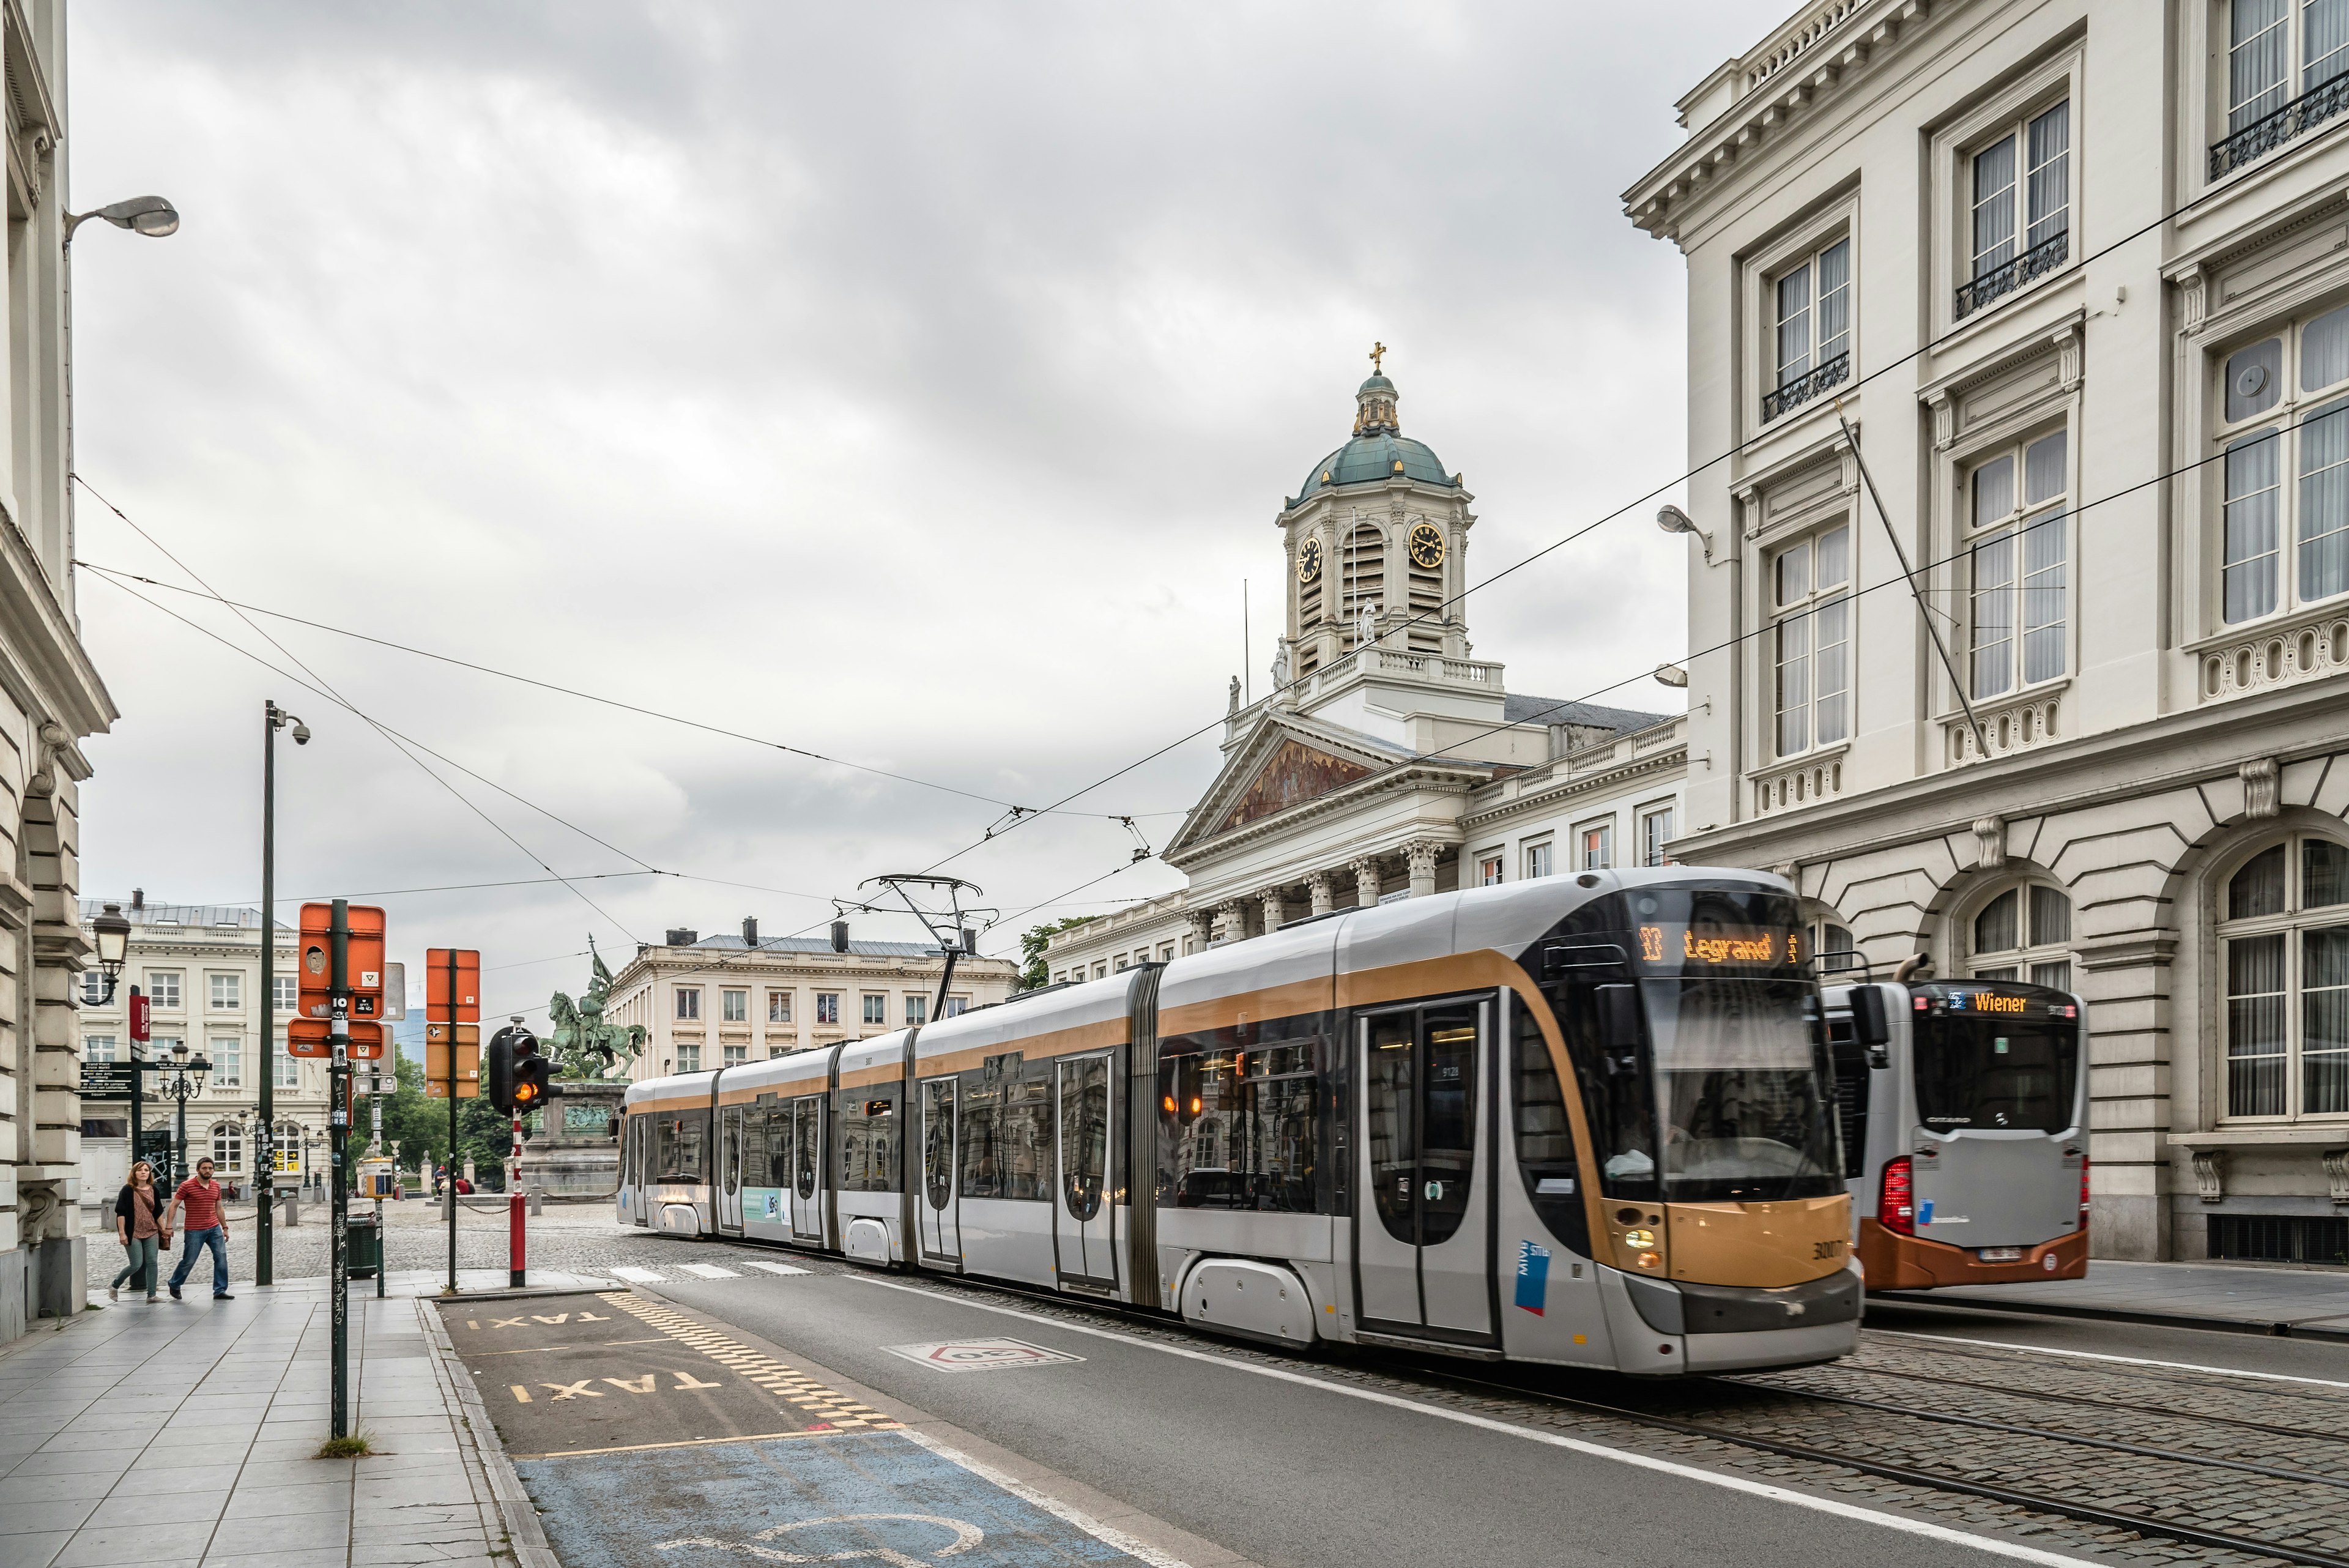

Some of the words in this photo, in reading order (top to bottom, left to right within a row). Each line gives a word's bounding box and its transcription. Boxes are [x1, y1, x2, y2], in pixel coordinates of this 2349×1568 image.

[1683, 930, 1772, 962] Legrand
[1975, 992, 2026, 1013] Wiener
[273, 1151, 284, 1170] info
[1518, 1242, 1529, 1276] MIVB
[466, 1312, 611, 1330] TAXI
[951, 1350, 1016, 1359] 30
[509, 1372, 722, 1404] TAXI
